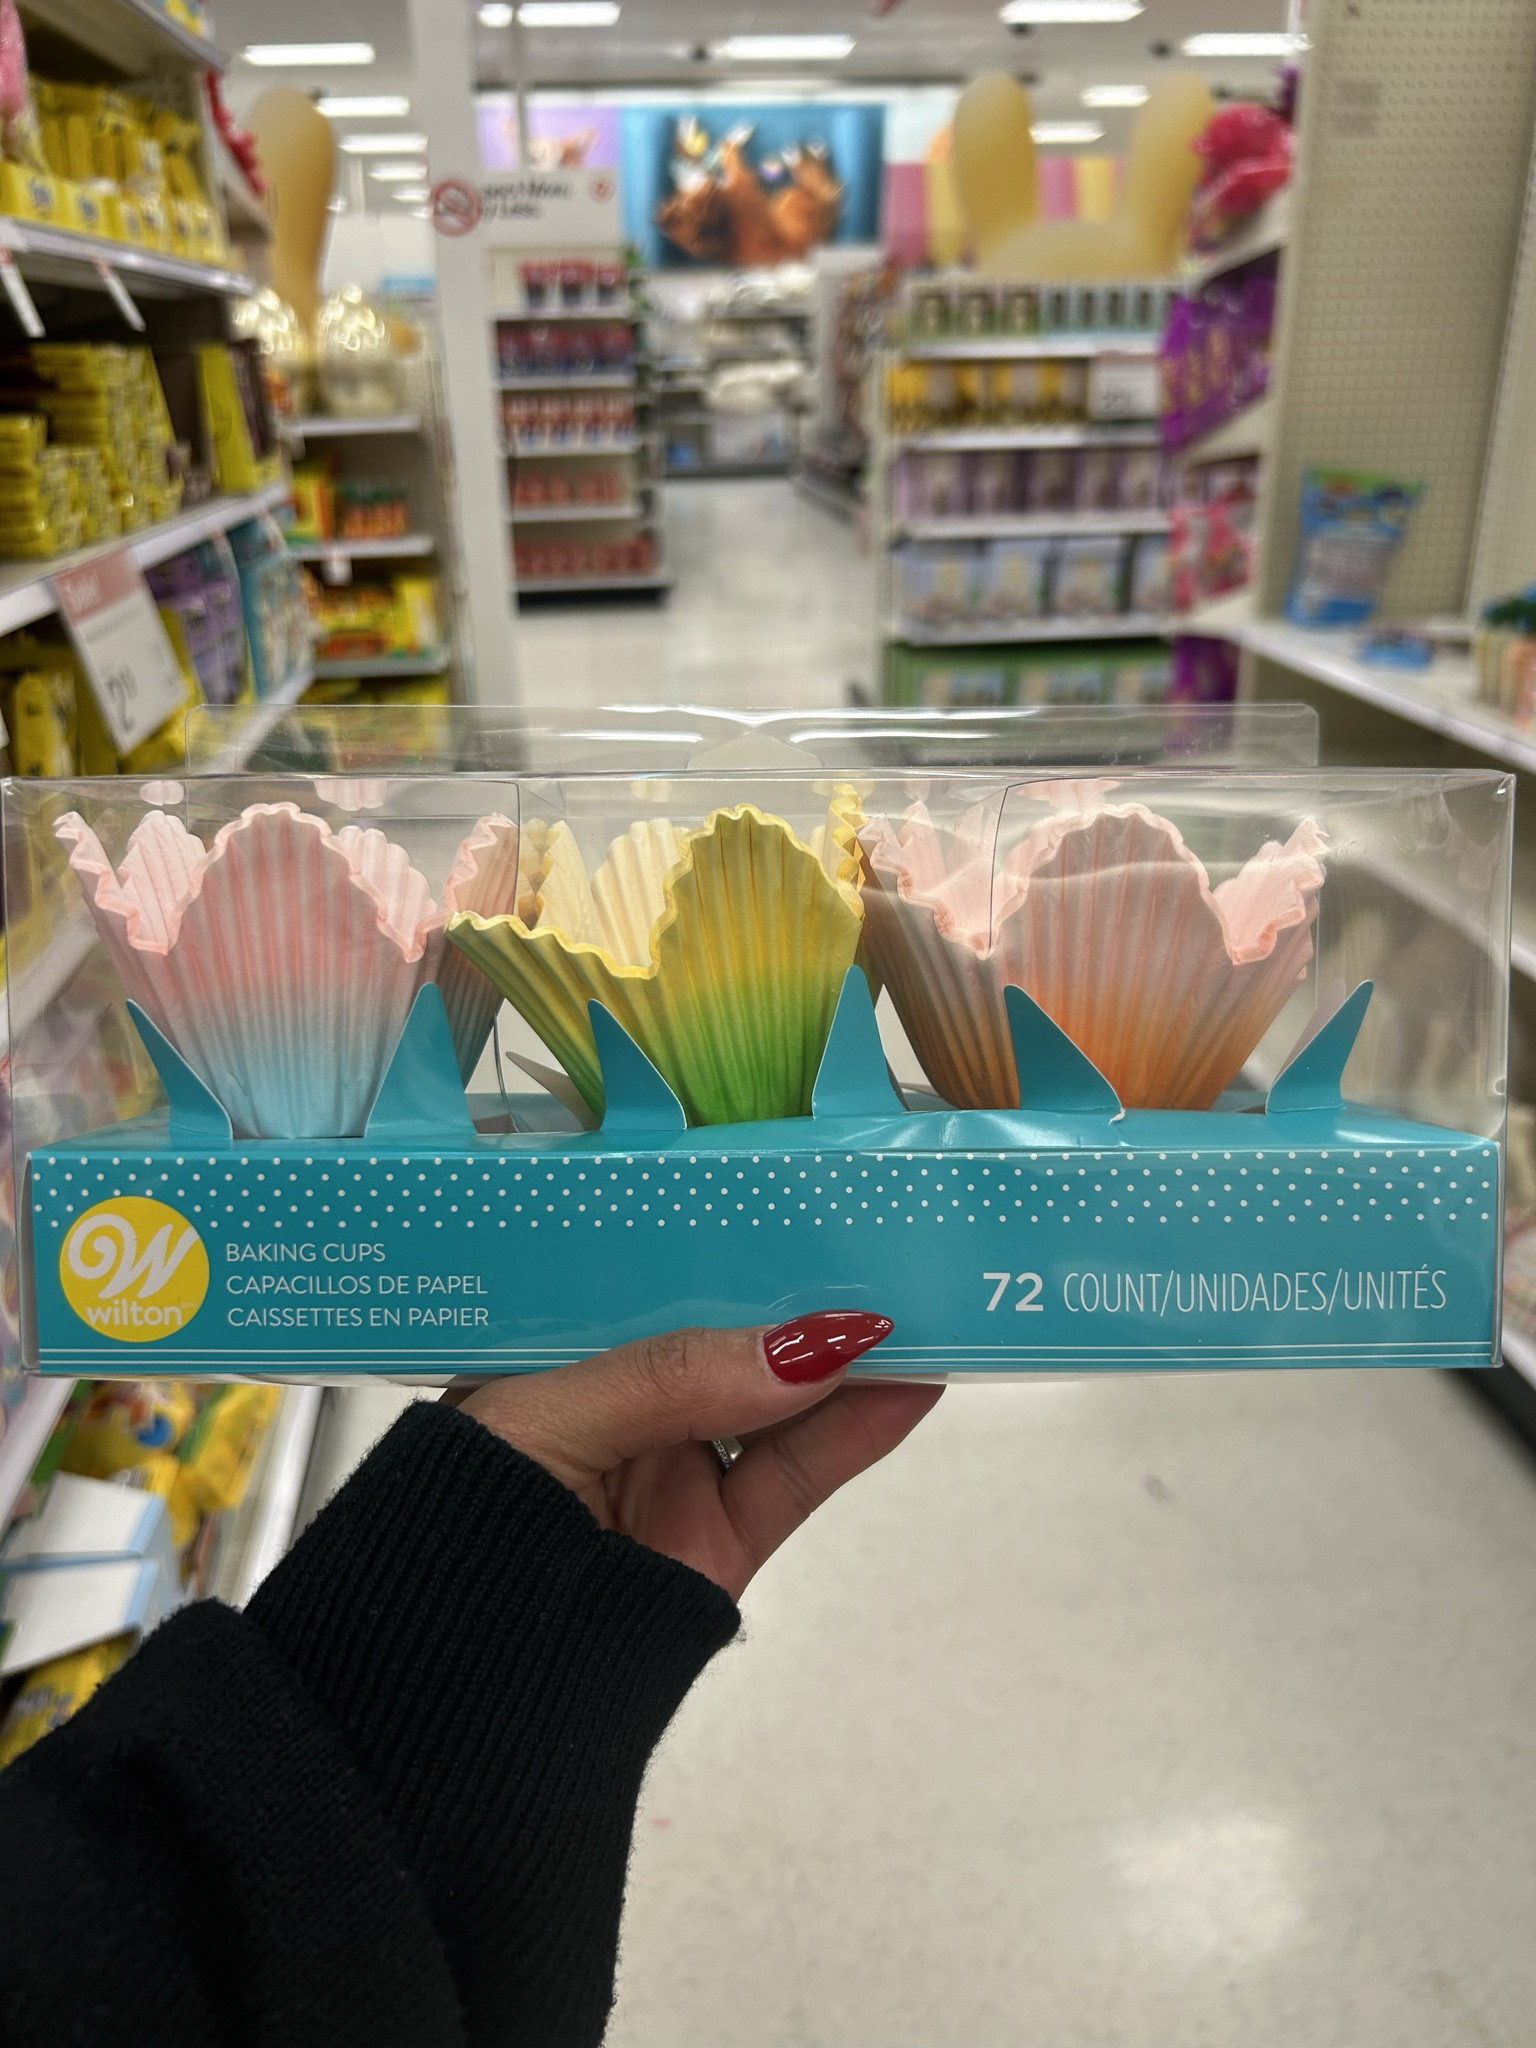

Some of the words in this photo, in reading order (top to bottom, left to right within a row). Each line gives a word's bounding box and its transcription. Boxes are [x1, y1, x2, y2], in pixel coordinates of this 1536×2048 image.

[226, 1242, 317, 1263] BAKING
[322, 1242, 386, 1263] CUPS
[226, 1274, 372, 1296] CAPACILLOS
[378, 1274, 411, 1296] DE
[417, 1274, 489, 1296] PAPEL
[982, 1271, 1045, 1312] 72
[1063, 1263, 1448, 1318] COUNT/UNIDADES/UNITÉS
[86, 1298, 183, 1326] wilton
[227, 1307, 363, 1328] CAISSETTES
[369, 1307, 401, 1327] EN
[408, 1307, 490, 1327] PAPIER
